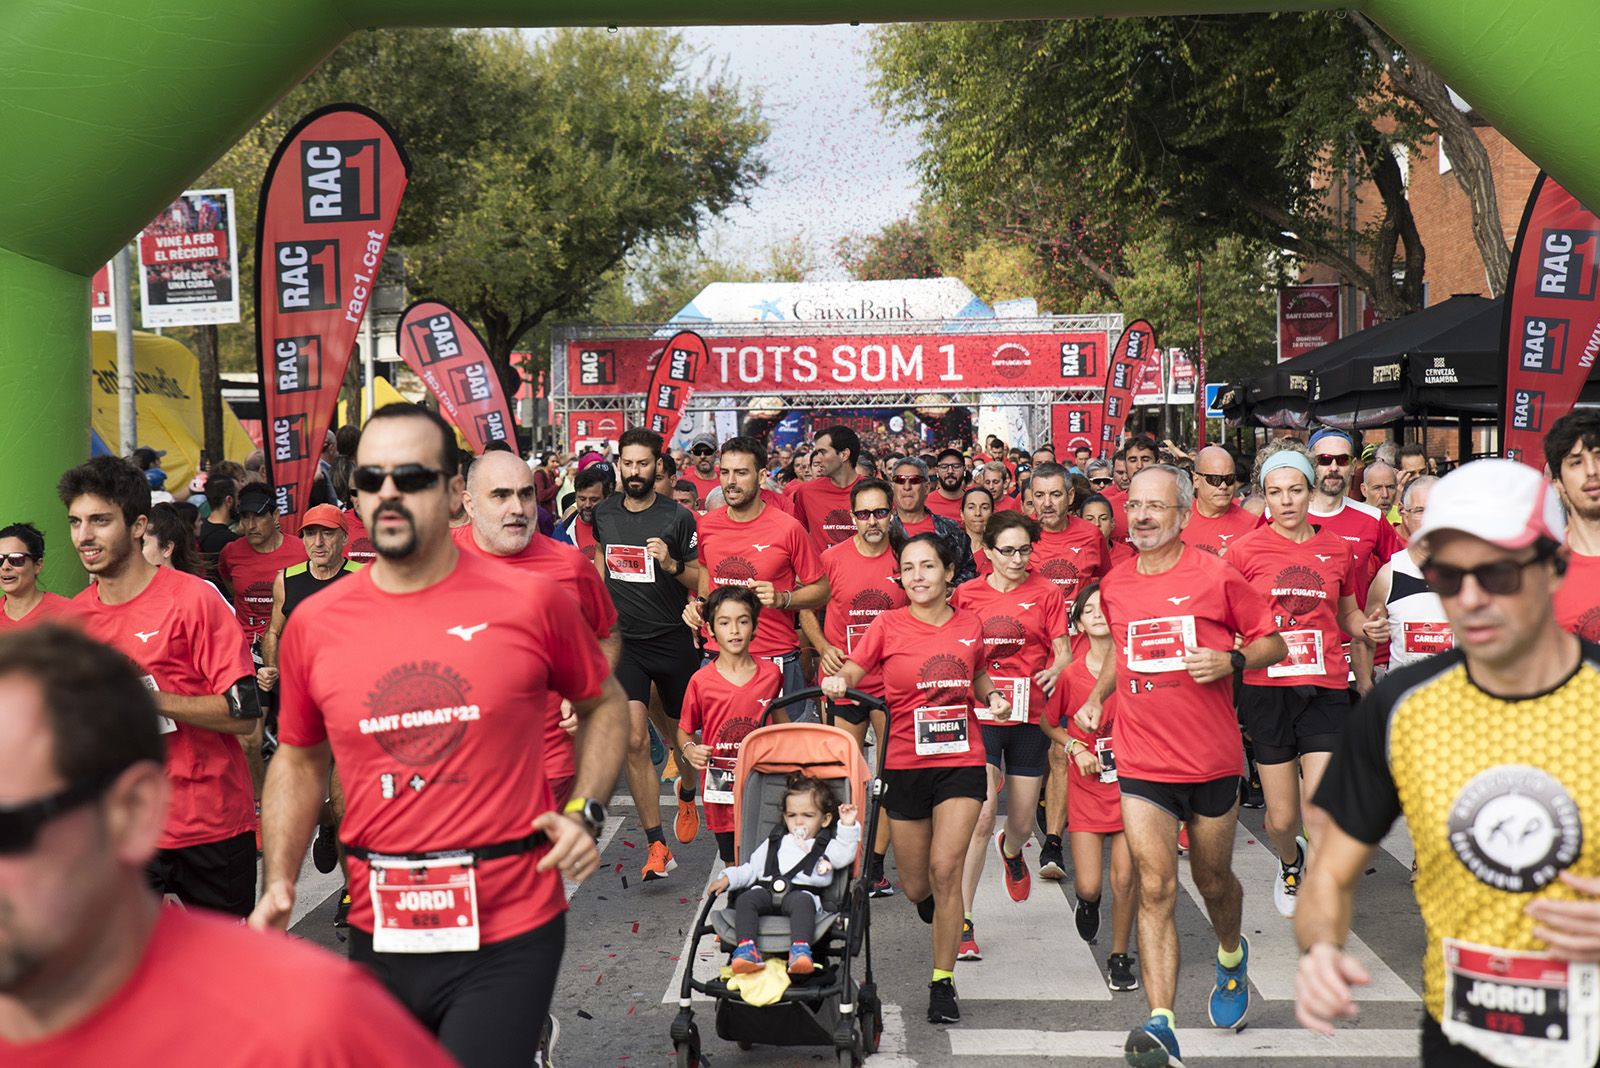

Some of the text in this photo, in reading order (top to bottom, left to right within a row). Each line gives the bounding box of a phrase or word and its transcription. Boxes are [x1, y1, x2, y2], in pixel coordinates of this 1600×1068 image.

[307, 145, 375, 217] RAC 1
[156, 233, 214, 248] VINE A FER
[154, 251, 168, 261] EL
[1541, 234, 1599, 296] RAC 1
[279, 245, 337, 309] RAC 1
[345, 229, 384, 323] rac1.cat
[792, 298, 914, 321] CaixaBank
[1127, 331, 1140, 358] RAC
[1524, 320, 1566, 370] RAC 1
[277, 341, 298, 391] RAC
[582, 352, 598, 384] RAC
[671, 350, 687, 379] RAC
[711, 345, 818, 383] TOTS
[832, 344, 923, 383] SOM
[938, 344, 963, 381] 1
[1062, 343, 1079, 376] RAC
[1080, 343, 1094, 375] 1
[1426, 368, 1455, 376] CERVEZAS
[1114, 363, 1125, 388] RAC
[1425, 375, 1458, 384] ALHAMBRA
[659, 386, 671, 407] RAC
[1070, 412, 1080, 432] RAC
[1514, 392, 1529, 428] RAC
[274, 419, 291, 461] RAC
[276, 487, 288, 515] RAC
[1271, 588, 1291, 596] SANT
[1288, 645, 1308, 656] NNA
[1414, 634, 1445, 643] CARLES
[916, 680, 937, 689] SANT
[359, 715, 400, 734] SANT
[928, 722, 960, 733] MIREIA
[395, 889, 455, 911] JORDI
[1466, 980, 1547, 1015] JORDI
